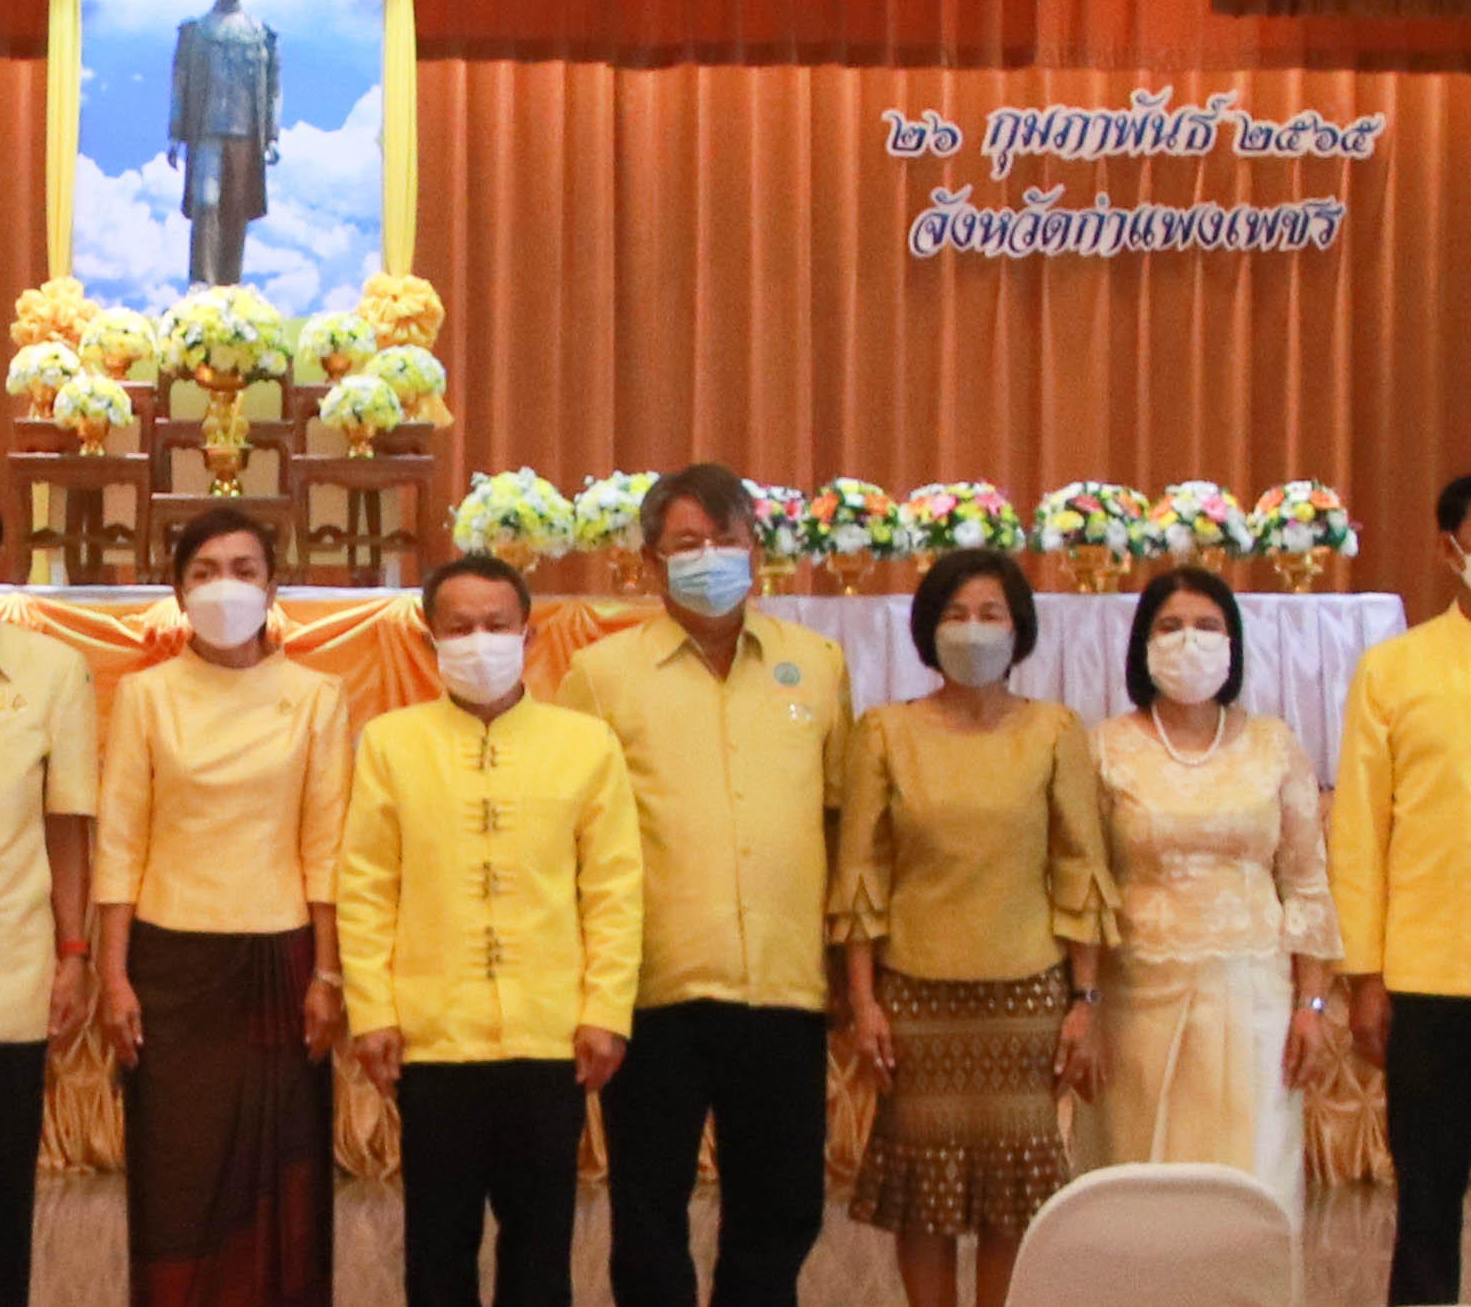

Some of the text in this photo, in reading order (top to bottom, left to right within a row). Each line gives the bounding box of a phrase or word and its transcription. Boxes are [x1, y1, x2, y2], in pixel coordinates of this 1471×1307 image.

[885, 87, 1380, 176] ๒๖ กุมภาพันธ์ ๒๕๖๕
[912, 186, 1343, 255] จังหวัดกำแพงเพชร
